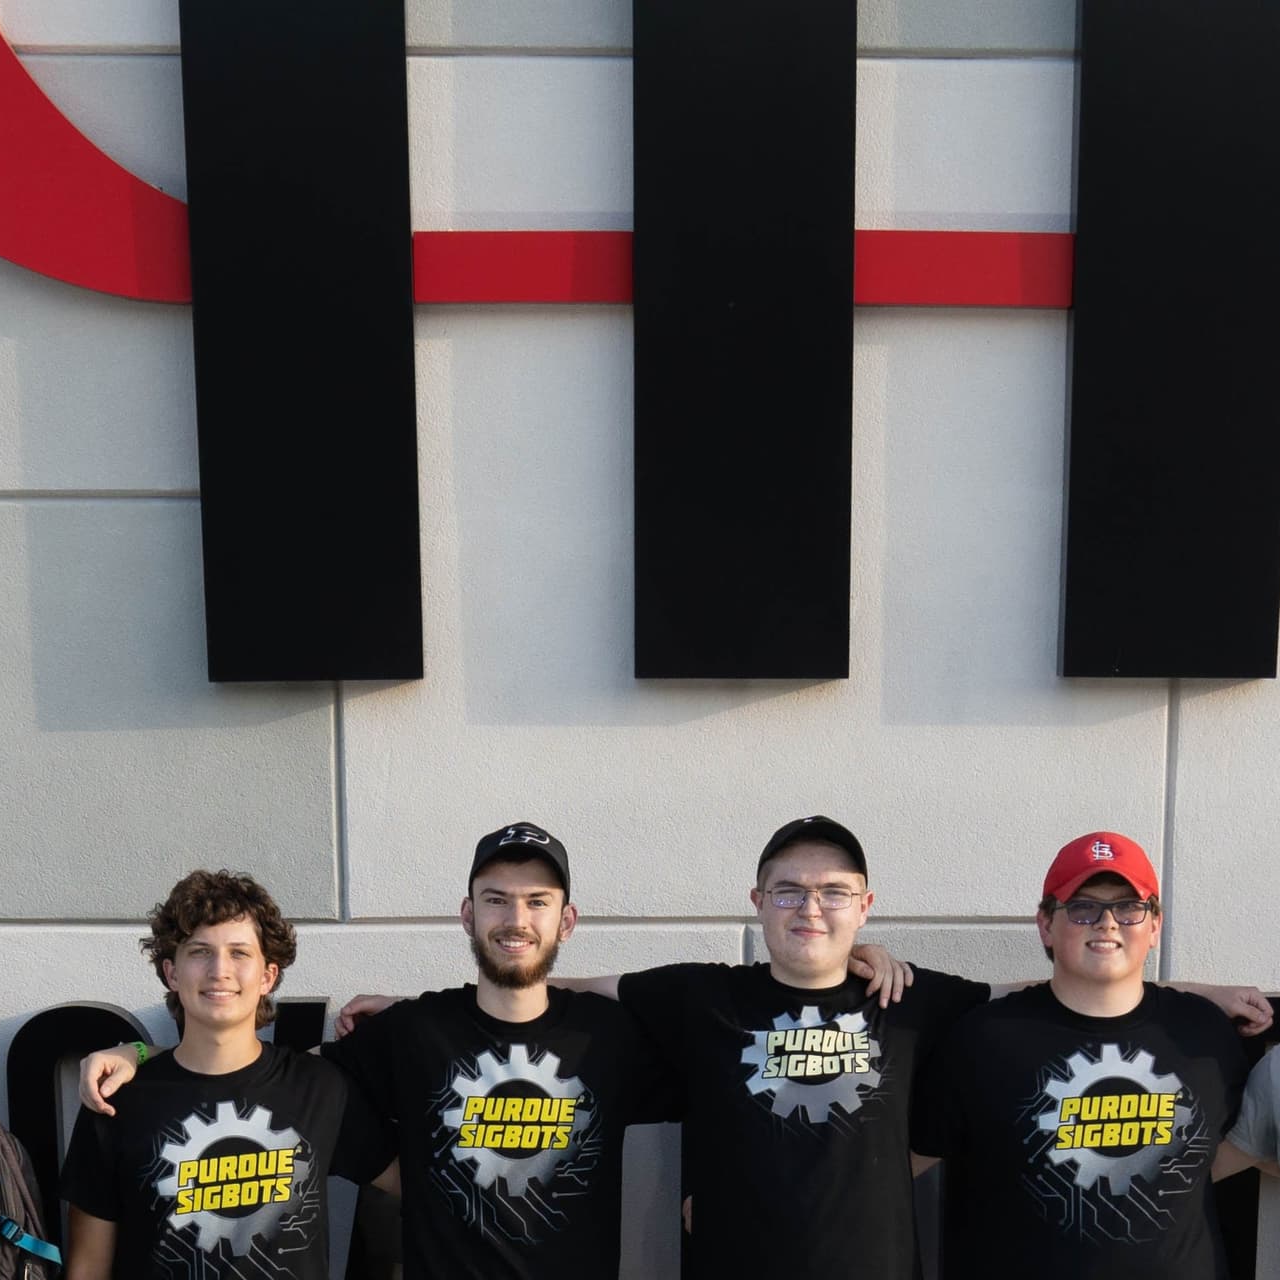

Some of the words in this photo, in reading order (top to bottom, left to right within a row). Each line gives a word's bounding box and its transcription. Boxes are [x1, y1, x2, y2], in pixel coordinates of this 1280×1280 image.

[767, 1029, 870, 1054] PURDUE
[762, 1052, 870, 1078] SIGBOTS
[463, 1096, 577, 1123] PURDUE
[1060, 1094, 1175, 1122] PURDUE
[458, 1123, 573, 1149] SIGBOTS
[1055, 1120, 1174, 1149] SIGBOTS
[179, 1149, 295, 1187] PURDUE
[176, 1176, 293, 1215] SIGBOTS
